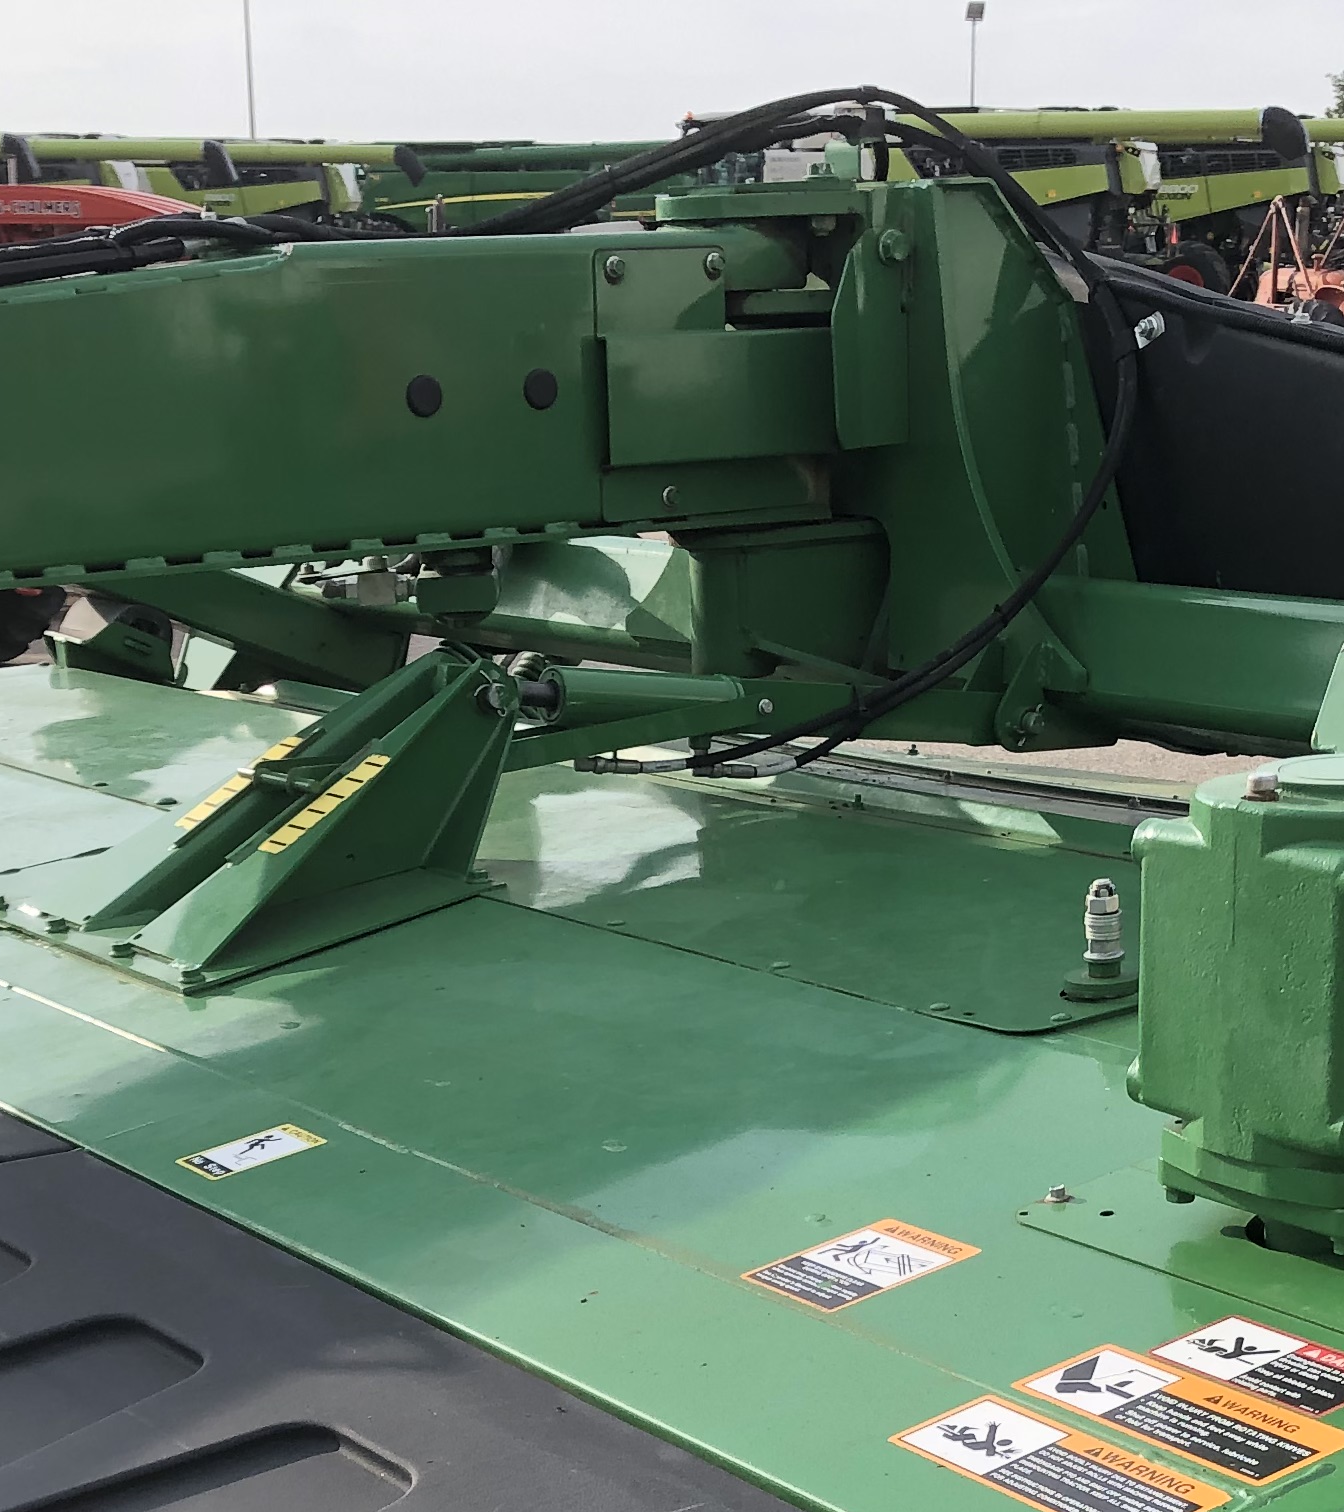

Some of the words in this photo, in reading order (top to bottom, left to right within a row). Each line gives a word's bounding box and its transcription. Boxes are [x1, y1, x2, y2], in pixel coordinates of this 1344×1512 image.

[896, 1229, 964, 1255] WARNING
[1252, 1367, 1276, 1376] Keep
[1278, 1376, 1310, 1389] shields
[1311, 1388, 1340, 1399] place.
[1121, 1417, 1144, 1427] fold
[1149, 1428, 1195, 1447] transport.
[1132, 1404, 1172, 1420] machine
[1173, 1420, 1213, 1436] running.
[1143, 1400, 1170, 1411] Keep
[1163, 1408, 1195, 1421] hands
[1188, 1418, 1211, 1427] and
[1203, 1424, 1227, 1434] feet
[1220, 1430, 1249, 1442] away
[1241, 1439, 1272, 1451] while
[1147, 1392, 1181, 1405] AVOID
[1172, 1401, 1211, 1417] INJURY
[1203, 1413, 1237, 1427] FROM
[1228, 1423, 1281, 1444] ROTATING
[1273, 1441, 1313, 1457] KNIVES
[1221, 1399, 1301, 1433] WARNING
[1122, 1409, 1147, 1420] Shut
[1152, 1421, 1185, 1435] power
[1218, 1447, 1262, 1465] lubricate
[1059, 1459, 1090, 1473] ADJUST
[1100, 1450, 1196, 1495] WARNING
